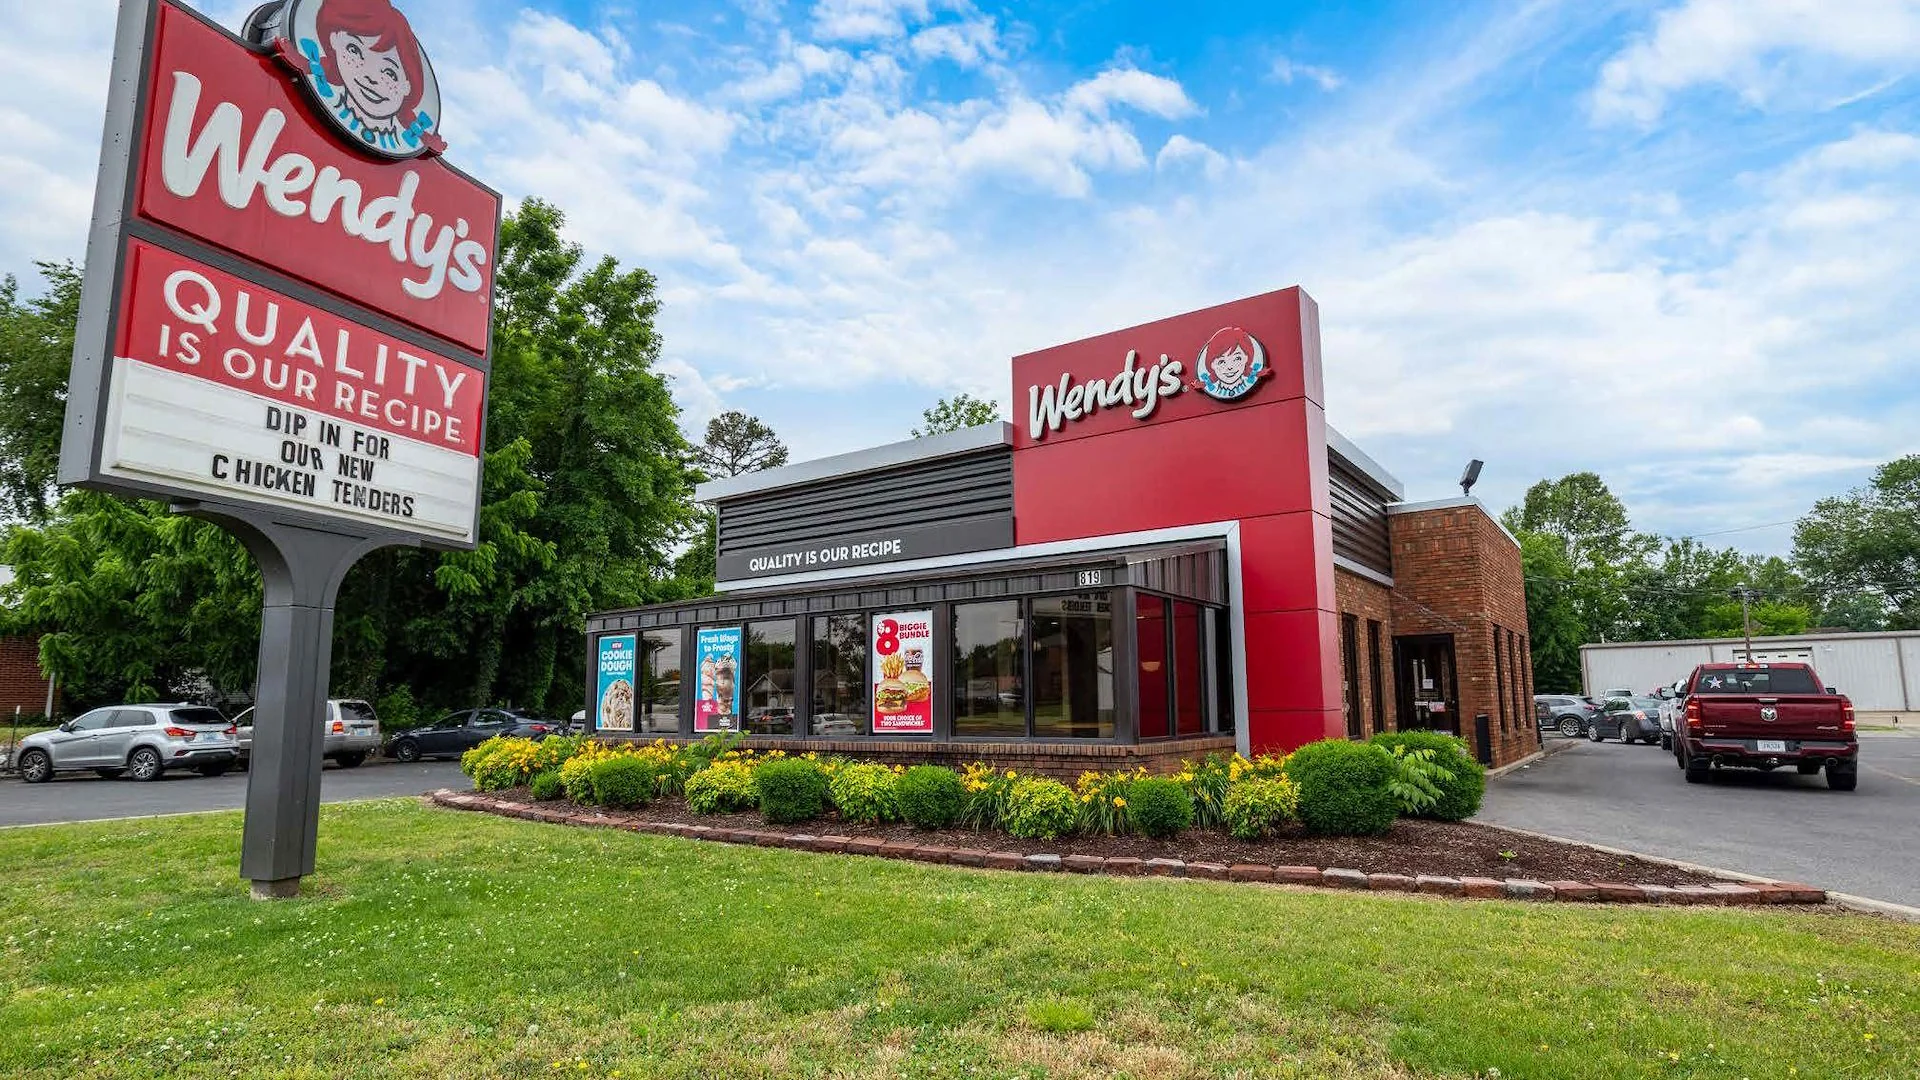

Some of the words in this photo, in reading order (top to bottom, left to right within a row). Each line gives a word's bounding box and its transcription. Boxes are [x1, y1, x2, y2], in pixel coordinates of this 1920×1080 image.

[162, 71, 486, 300] Wendy's
[163, 269, 467, 408] QUALITY
[158, 324, 201, 365] IS
[222, 348, 318, 401] OUR
[1028, 349, 1183, 440] Wendy's
[266, 406, 307, 437] DIP
[319, 420, 340, 448] IN
[352, 430, 390, 460] FOR
[281, 440, 324, 471] OUR
[338, 453, 374, 483] NEW
[212, 454, 315, 498] CHICKEN
[331, 480, 415, 518] TENDERS
[749, 551, 803, 572] QUALITY
[805, 550, 817, 565] IS
[819, 546, 849, 563] OUR
[852, 539, 902, 559] RECIPE
[1080, 571, 1099, 585] 819
[899, 622, 927, 631] BIGGIE
[899, 630, 930, 640] BUNDLE
[600, 660, 633, 672] DOUGH
[601, 649, 633, 660] COOKIE
